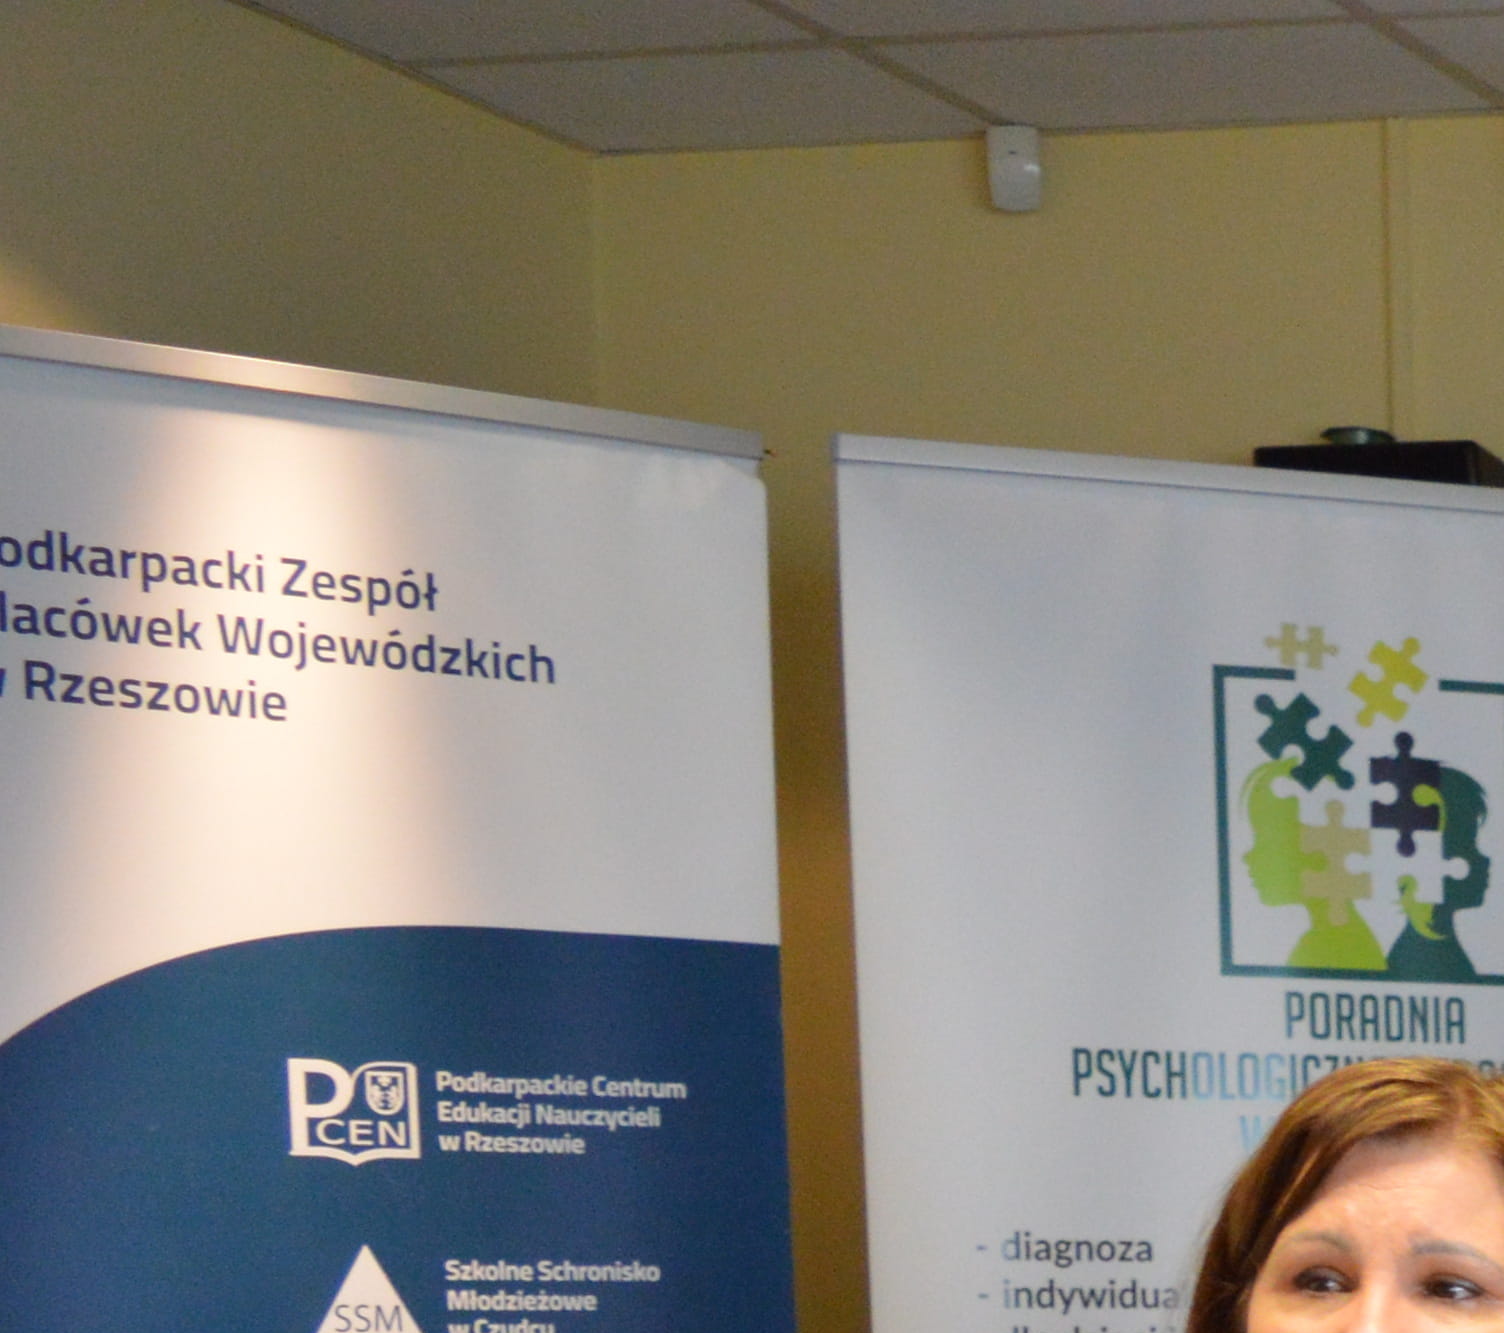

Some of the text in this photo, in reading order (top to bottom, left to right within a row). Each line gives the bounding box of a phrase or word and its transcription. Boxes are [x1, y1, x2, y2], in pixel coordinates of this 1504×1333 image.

[281, 557, 439, 616] Zespół
[217, 613, 557, 685] Wojewódzkich
[24, 658, 288, 722] Rzeszowie
[1285, 991, 1467, 1044] PORADNIA
[435, 1070, 687, 1100] Podkarpackie Centrum
[437, 1101, 661, 1131] Edukacji Nauczycieli
[439, 1131, 586, 1155] w Rzeszowie
[1001, 1232, 1154, 1267] diagnoza
[444, 1260, 661, 1283] Szkolne Schronisko
[446, 1288, 598, 1313] Młodzieżowe
[334, 1304, 404, 1333] SSM
